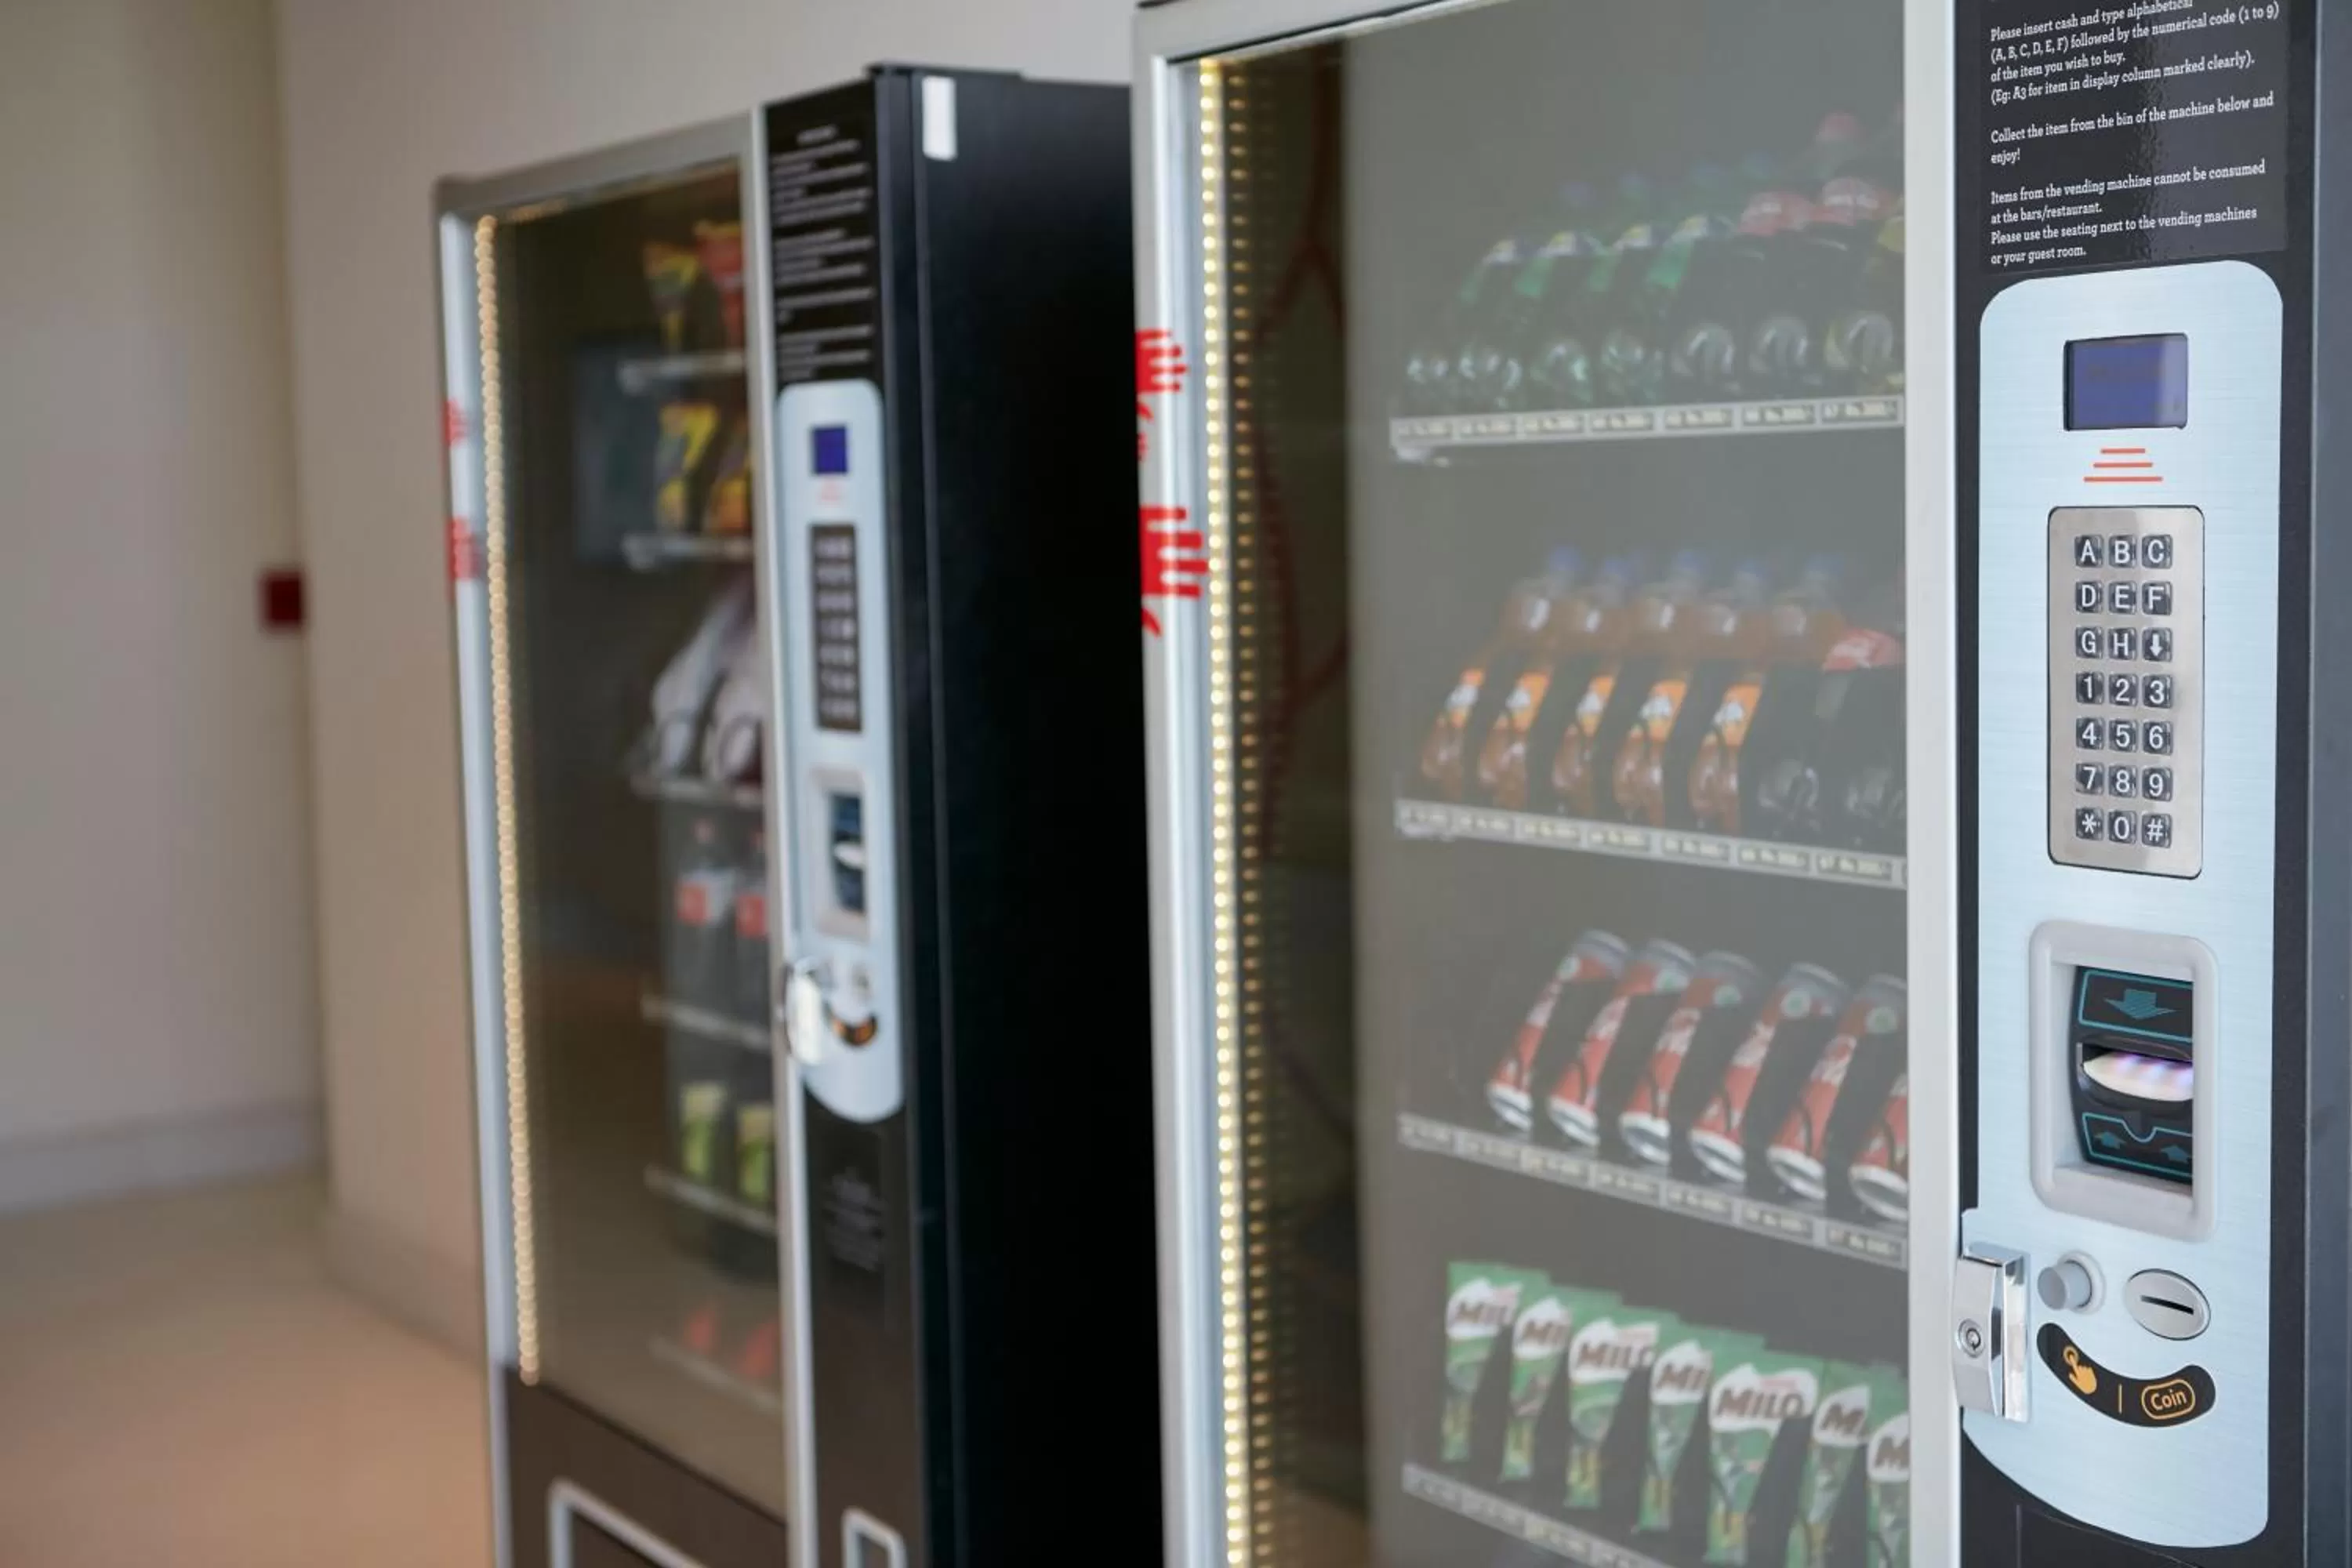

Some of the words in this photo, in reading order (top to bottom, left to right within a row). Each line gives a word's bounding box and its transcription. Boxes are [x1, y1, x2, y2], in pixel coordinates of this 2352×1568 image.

[1991, 26, 2021, 41] Please
[2024, 20, 2053, 35] insert
[2055, 13, 2078, 30] cash
[2080, 9, 2099, 25] and
[2101, 9, 2125, 24] type
[1991, 48, 2006, 64] (A,
[2008, 45, 2017, 60] B,
[2020, 43, 2031, 58] C,
[2033, 42, 2043, 56] D,
[2045, 39, 2055, 53] E,
[2056, 35, 2069, 53] F)
[2071, 27, 2114, 49] followed
[2118, 26, 2129, 43] by
[2132, 23, 2150, 38] the
[2151, 12, 2207, 34] numerical
[2209, 8, 2236, 26] code
[2238, 5, 2249, 24] (1
[2252, 7, 2263, 19] to
[2267, 1, 2279, 20] 9)
[1991, 67, 2001, 82] of
[2002, 66, 2018, 80] the
[2020, 65, 2042, 78] item
[2045, 62, 2063, 76] you
[2065, 53, 2089, 70] wish
[2091, 55, 2101, 65] to
[2103, 49, 2126, 65] buy.
[1991, 88, 2011, 105] (Eg:
[2013, 86, 2026, 100] A3
[2028, 82, 2042, 96] for
[2045, 82, 2067, 94] item
[2070, 78, 2080, 90] in
[2082, 71, 2119, 89] display
[2122, 66, 2161, 82] column
[2163, 56, 2205, 76] marked
[2207, 49, 2255, 69] clearly).
[1991, 126, 2025, 143] Collect
[2027, 123, 2043, 137] the
[2045, 122, 2068, 135] item
[2071, 117, 2096, 132] from
[2097, 114, 2114, 128] the
[2116, 111, 2133, 125] bin
[2135, 107, 2147, 123] of
[2149, 106, 2165, 122] the
[2169, 100, 2214, 119] machine
[2217, 95, 2250, 112] below
[2252, 90, 2274, 108] and
[1991, 148, 2020, 165] enjoy!
[1991, 191, 2018, 205] Items
[2020, 186, 2043, 201] from
[2045, 183, 2062, 198] the
[2063, 178, 2105, 195] vending
[2107, 173, 2151, 191] machine
[2154, 172, 2191, 185] cannot
[2193, 165, 2206, 180] be
[2209, 158, 2265, 178] consumed
[1991, 213, 2001, 224] at
[2003, 209, 2019, 223] the
[2020, 202, 2102, 222] bars/restaurant.
[1991, 230, 2021, 245] Please
[2024, 230, 2040, 241] use
[2042, 224, 2059, 238] the
[2060, 222, 2098, 237] seating
[2100, 221, 2122, 233] next
[2125, 219, 2136, 230] to
[2138, 214, 2156, 229] the
[2158, 210, 2201, 227] vending
[2204, 206, 2257, 223] machines
[1991, 254, 2002, 264] or
[2004, 252, 2026, 267] your
[2027, 248, 2055, 263] guest
[2057, 246, 2086, 258] room.
[2081, 539, 2096, 563] A
[2114, 540, 2130, 563] B
[2147, 539, 2164, 563] C
[2082, 584, 2096, 607] D
[2115, 585, 2130, 608] E
[2148, 586, 2164, 609] F
[2082, 630, 2096, 653] G
[2113, 633, 2129, 655] H
[2083, 675, 2092, 699] 1
[2116, 678, 2129, 702] 2
[2150, 680, 2164, 704] 3
[2082, 722, 2097, 745] 4
[2116, 724, 2129, 747] 5
[2149, 725, 2163, 749] 6
[2083, 766, 2096, 789] 7
[2116, 770, 2129, 793] 8
[2149, 773, 2163, 797] 9
[2147, 818, 2163, 841] #
[1715, 1387, 1804, 1418] MILO
[2151, 1388, 2187, 1411] Coin
